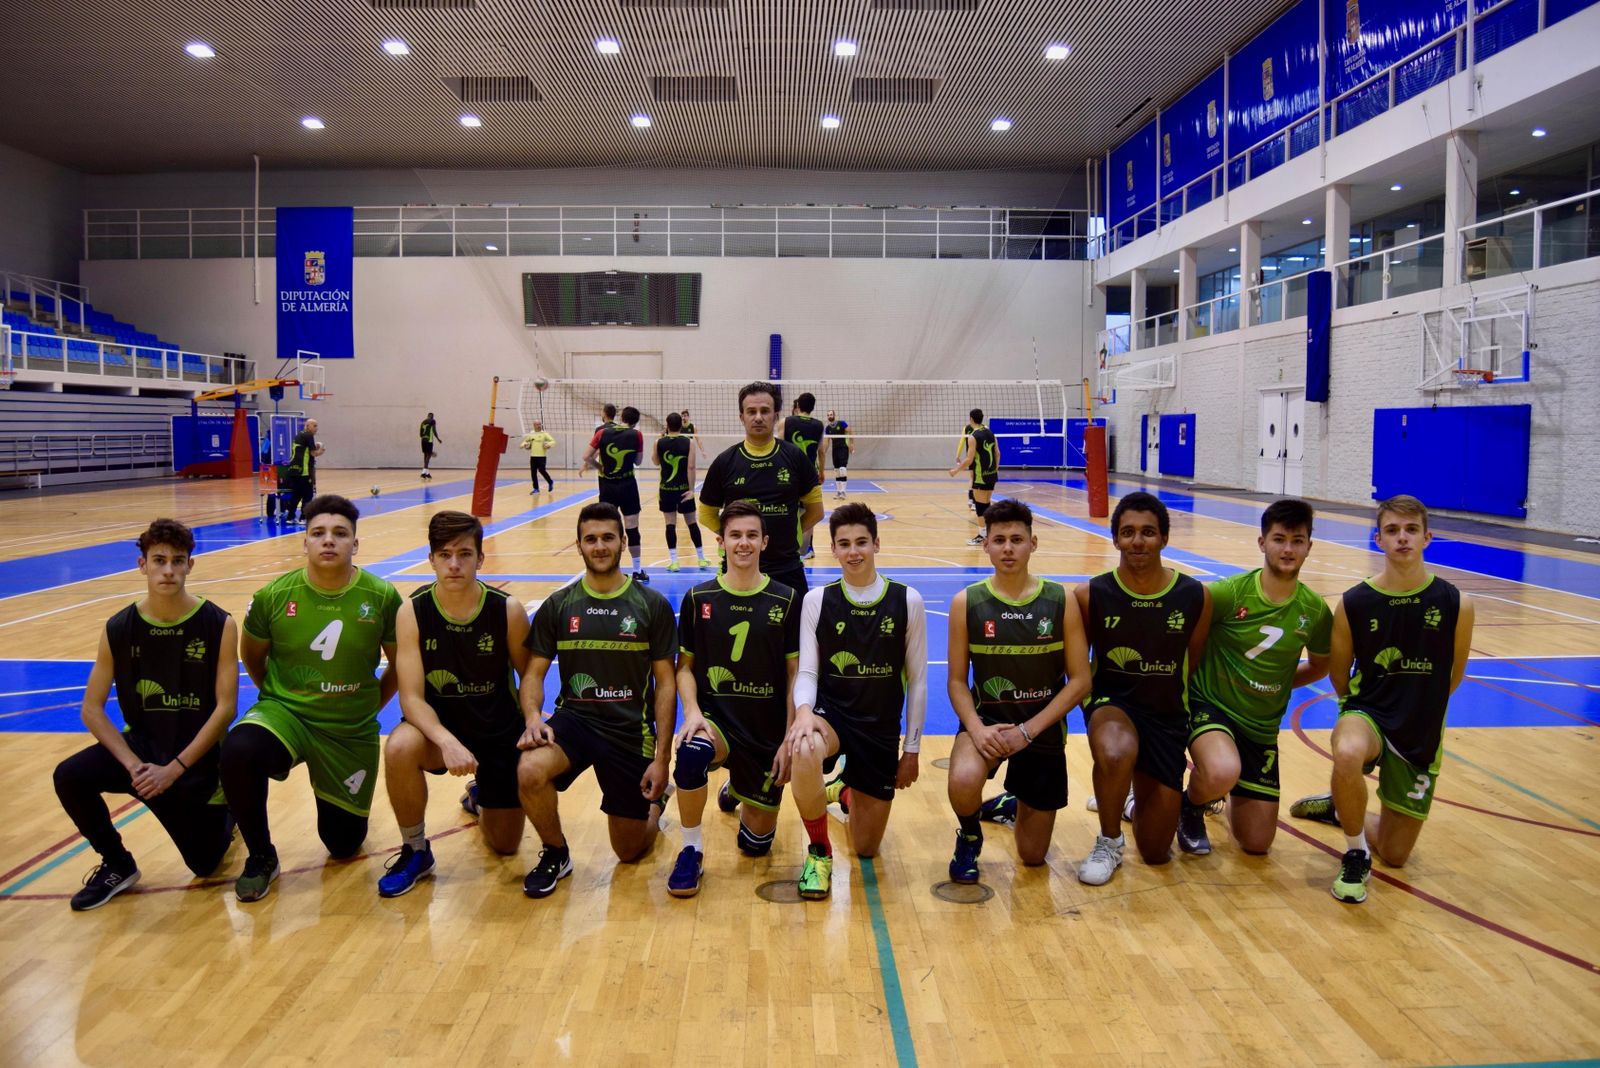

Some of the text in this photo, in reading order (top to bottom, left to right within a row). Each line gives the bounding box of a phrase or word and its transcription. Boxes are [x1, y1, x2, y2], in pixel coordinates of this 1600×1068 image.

[280, 288, 350, 301] DIPUTACIÓN
[281, 300, 349, 312] DE ALMERÍA
[734, 477, 746, 485] JR
[586, 606, 610, 615] daen
[1001, 611, 1025, 620] daen
[835, 621, 846, 635] 9
[1104, 616, 1121, 629] 17
[1369, 618, 1379, 632] 3
[309, 619, 344, 661] 4
[425, 638, 438, 651] 10
[728, 620, 750, 662] 1
[1244, 625, 1284, 660] 7
[857, 662, 893, 677] Unicaja
[595, 685, 633, 699] Unicaja
[733, 682, 774, 696] Unicaja
[1013, 686, 1052, 699] Unicaja
[162, 692, 200, 707] Uniaja
[1261, 750, 1277, 774] 7
[343, 769, 367, 795] 4
[1407, 774, 1430, 800] 3
